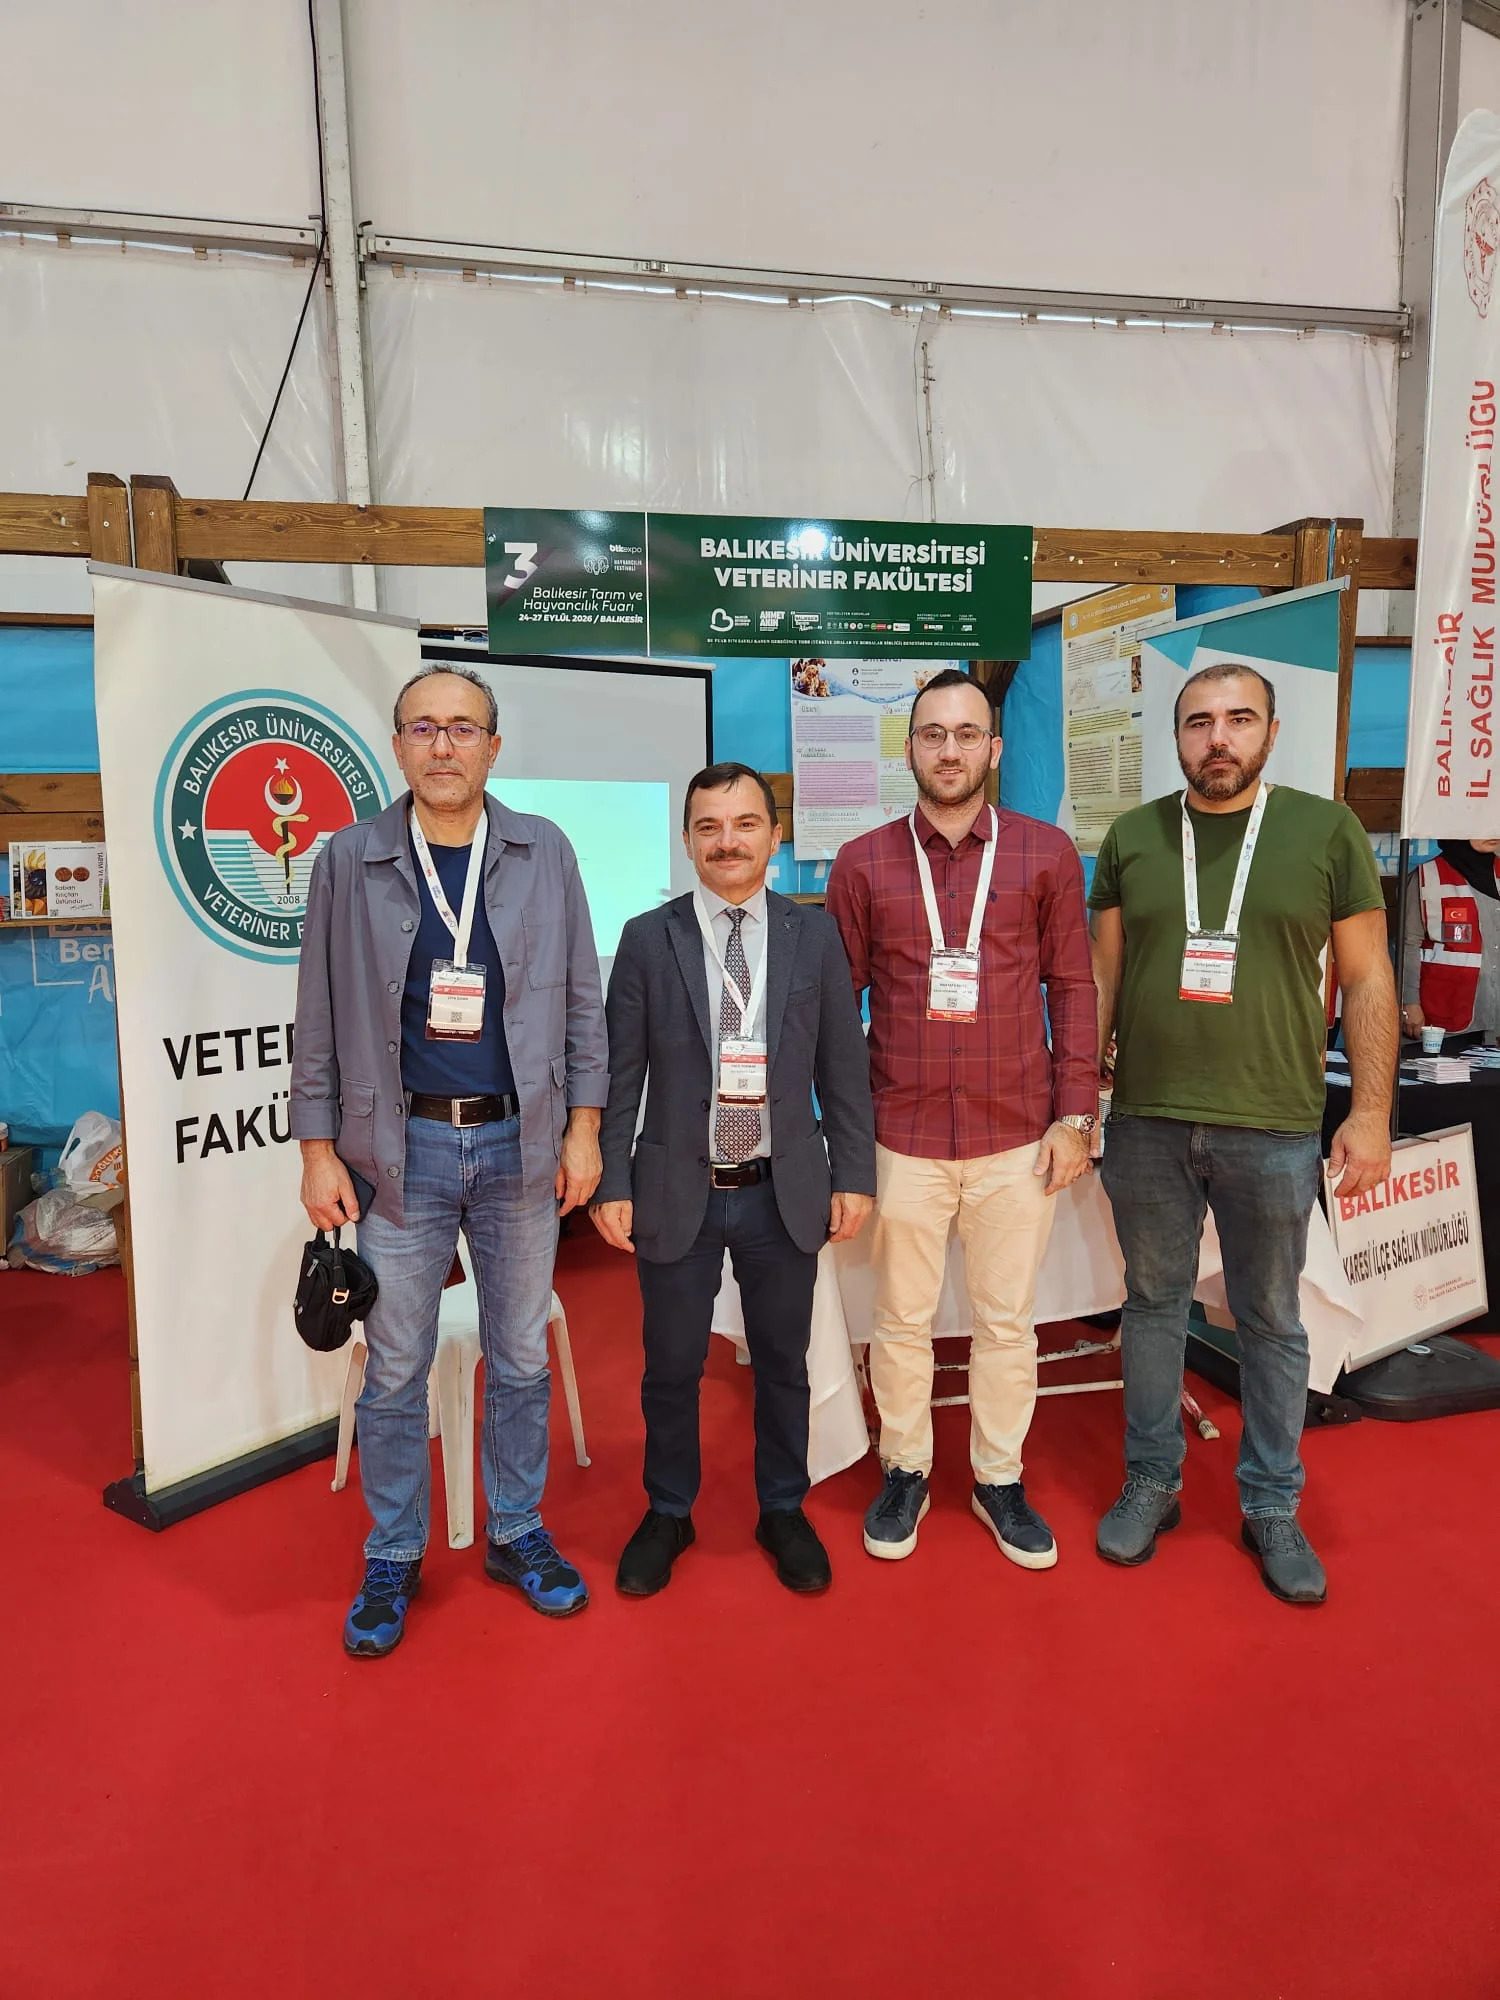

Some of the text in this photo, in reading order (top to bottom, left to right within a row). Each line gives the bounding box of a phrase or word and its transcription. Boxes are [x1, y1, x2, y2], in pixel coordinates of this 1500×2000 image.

[829, 536, 986, 565] ÜNİVERSİTESİ
[503, 542, 538, 589] 3
[713, 563, 973, 592] VETERİNER FAKÜLTESİ
[523, 599, 634, 613] Hayvancılık Fuarı
[533, 587, 643, 601] Balıkesir Tarım ve
[544, 613, 570, 622] EYLÜL
[600, 614, 643, 624] BALIKESİR
[1467, 626, 1496, 758] SAĞLIK
[182, 713, 375, 801] BALIKESİR ÜNİVERSİTESİ
[1466, 769, 1491, 798] İL
[202, 882, 291, 941] VETERİNER
[277, 895, 301, 905] 2008
[1339, 1158, 1460, 1222] BALIKESİR
[1372, 1239, 1392, 1280] İLÇE
[1392, 1229, 1422, 1269] SAĞLIK
[1420, 1211, 1469, 1257] MÜDÜRLÜĞÜ
